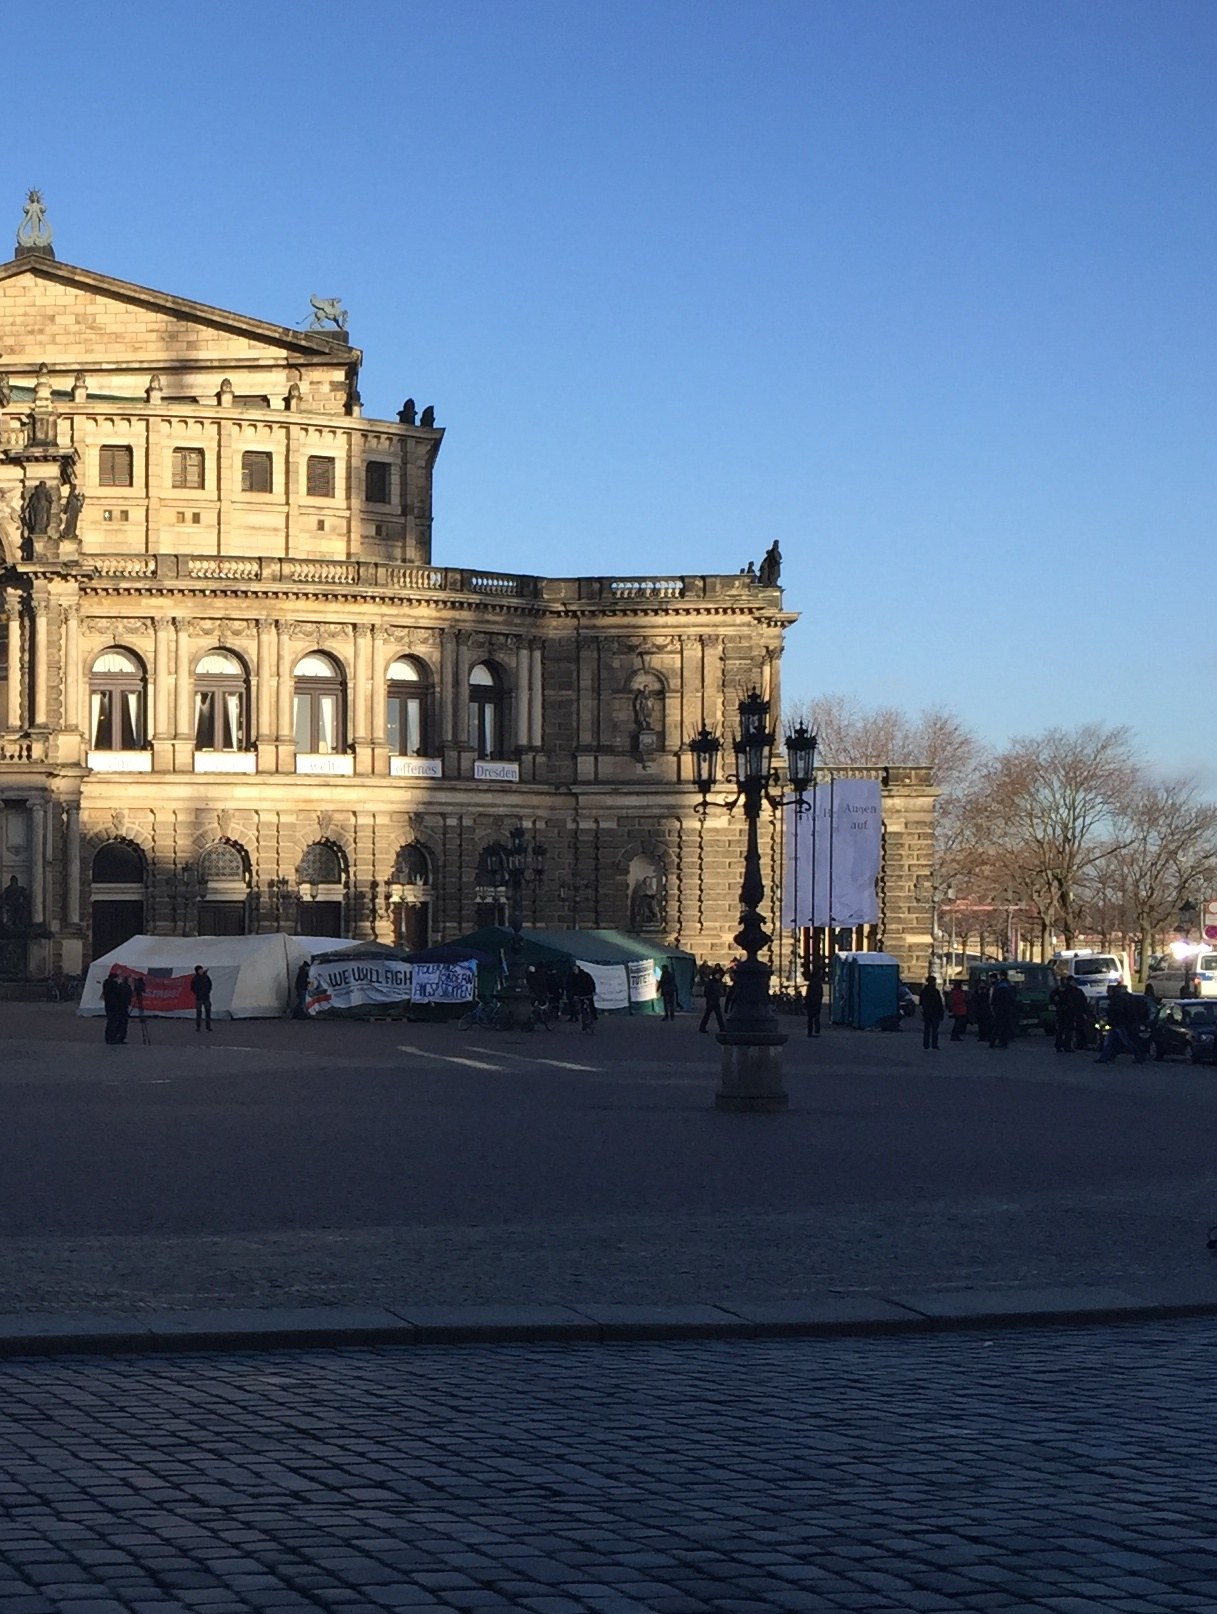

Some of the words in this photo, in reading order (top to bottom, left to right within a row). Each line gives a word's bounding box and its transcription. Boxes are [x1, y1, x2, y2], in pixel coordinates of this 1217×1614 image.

[395, 762, 437, 776] offenes
[476, 764, 517, 779] Dresden
[844, 803, 877, 815] Augen
[850, 820, 868, 830] auf
[328, 970, 349, 987] WE
[351, 966, 382, 984] WILL
[384, 968, 413, 986] FIGH
